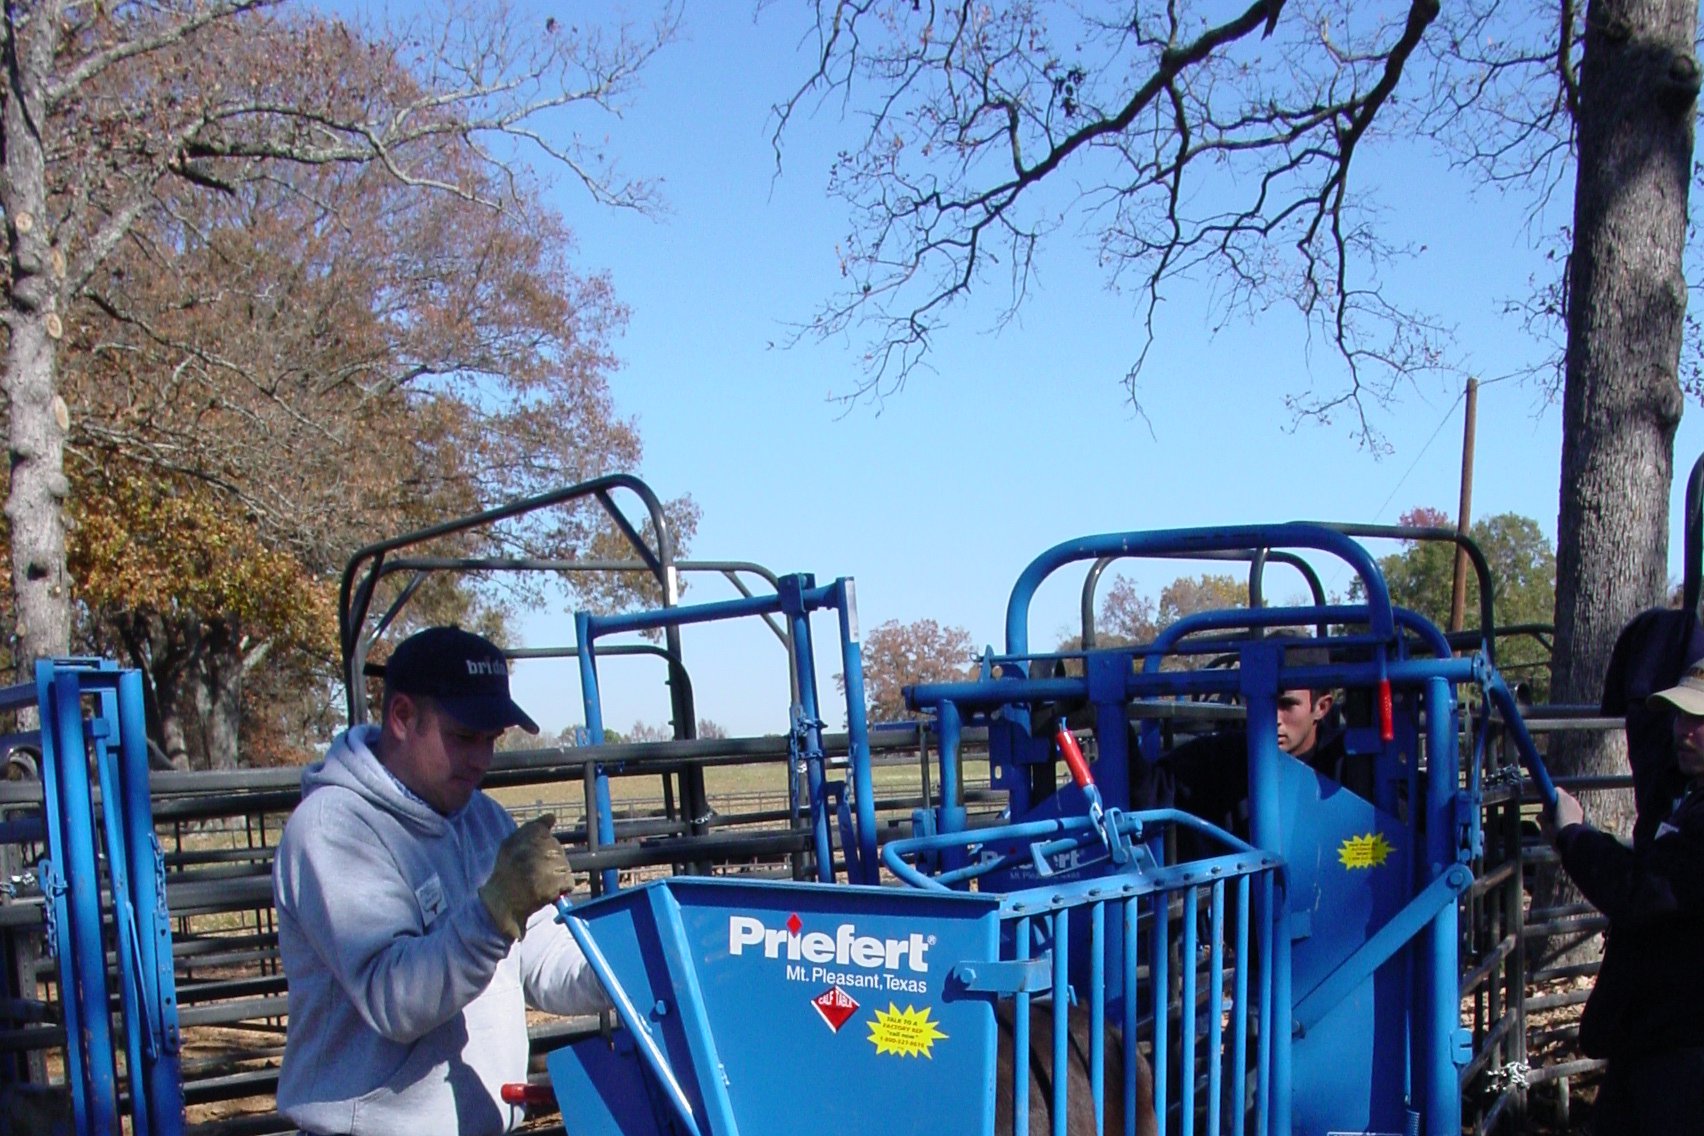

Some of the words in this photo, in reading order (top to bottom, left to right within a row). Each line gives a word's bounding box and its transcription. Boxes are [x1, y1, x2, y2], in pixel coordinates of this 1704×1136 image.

[729, 914, 929, 972] Priefert
[786, 964, 809, 982] Mt.
[812, 966, 883, 990] Pleasant,
[883, 973, 927, 993] Texas
[818, 990, 834, 1006] CALF
